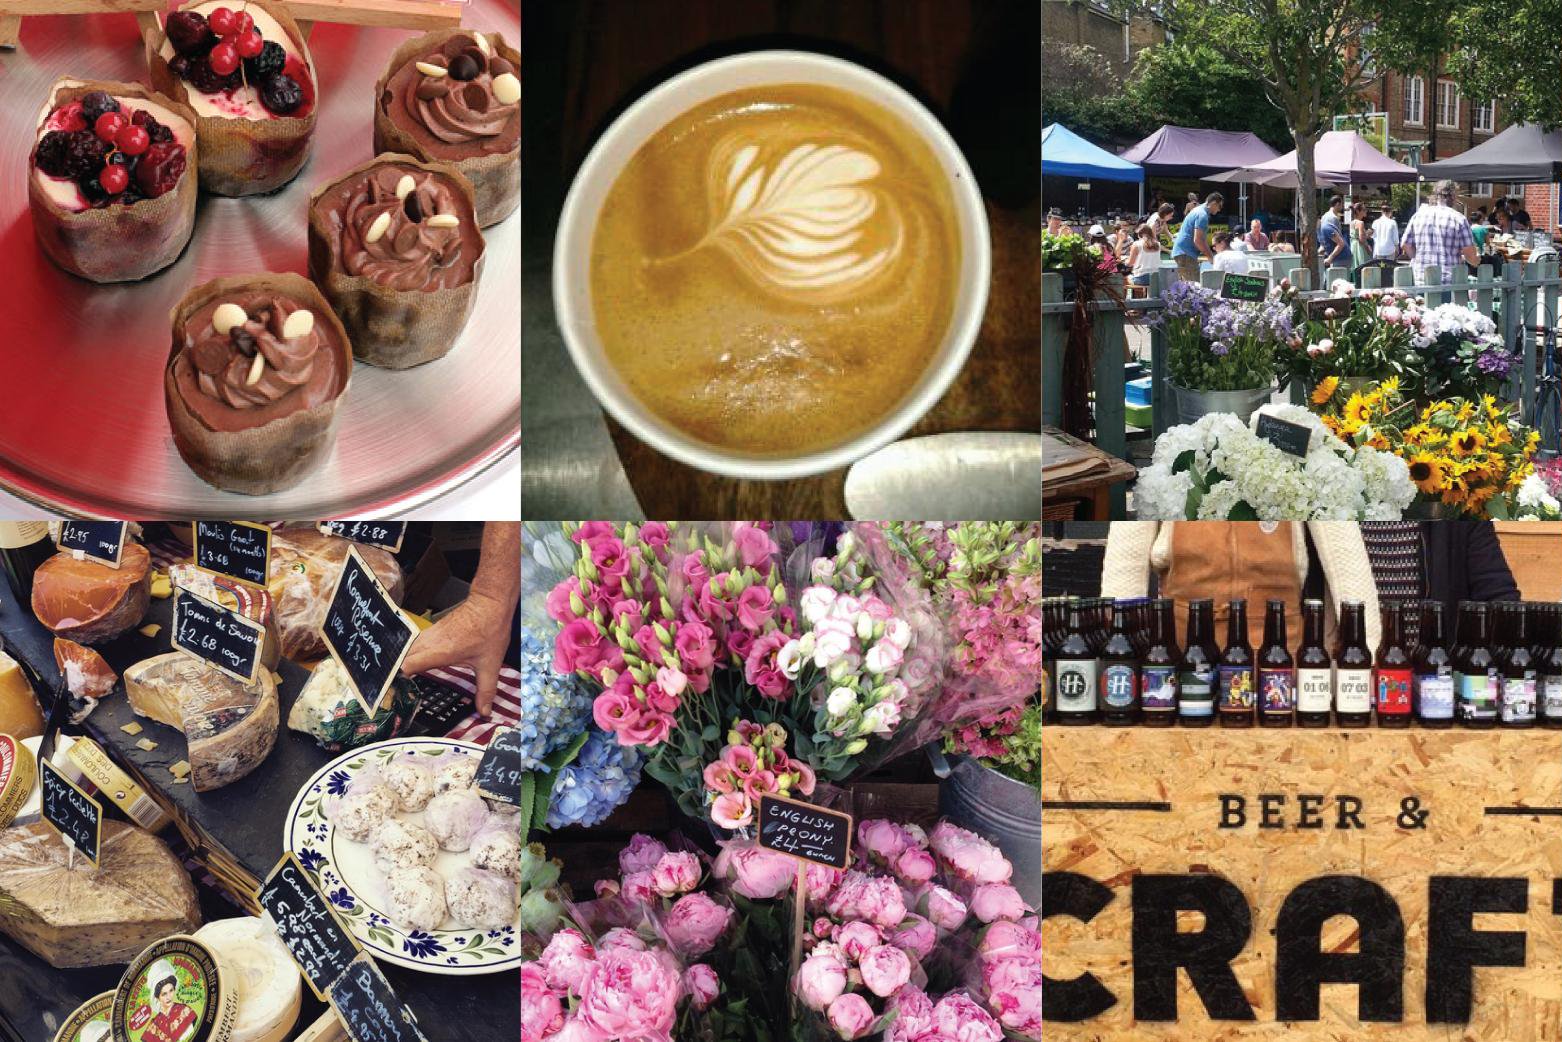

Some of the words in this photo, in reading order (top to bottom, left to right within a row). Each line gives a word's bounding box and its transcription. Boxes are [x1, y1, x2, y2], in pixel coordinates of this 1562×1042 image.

[178, 618, 217, 650] £2.68
[215, 618, 226, 631] de
[769, 805, 835, 831] ENGLISH
[1217, 794, 1366, 829] BEER
[1397, 796, 1430, 829] &
[326, 927, 338, 942] en
[1042, 870, 1562, 1024] CRAF
[302, 937, 326, 968] each
